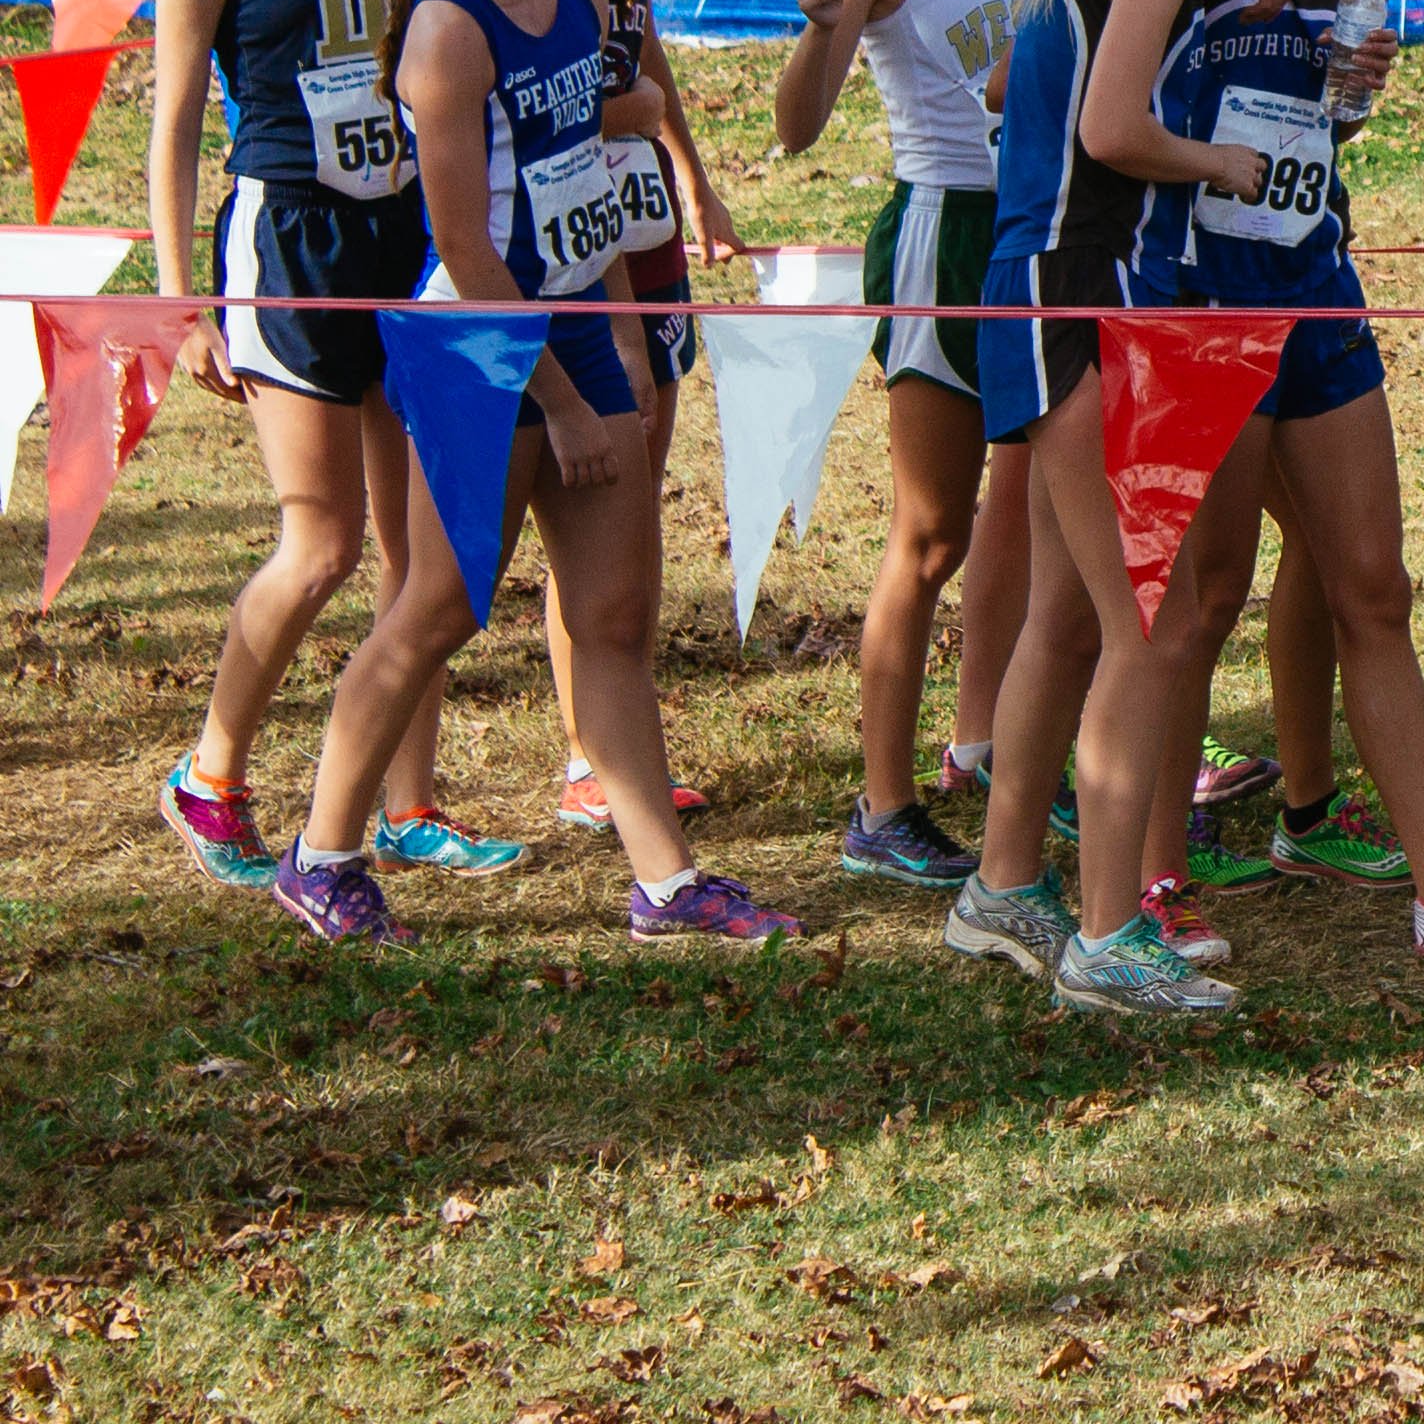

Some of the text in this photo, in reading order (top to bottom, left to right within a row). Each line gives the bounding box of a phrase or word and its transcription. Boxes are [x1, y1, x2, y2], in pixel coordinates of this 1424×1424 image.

[1209, 33, 1279, 63] SOUTH
[515, 66, 536, 83] asics
[334, 116, 412, 172] 55
[608, 173, 668, 222] 45
[1204, 152, 1326, 216] 093
[544, 189, 624, 267] 1855
